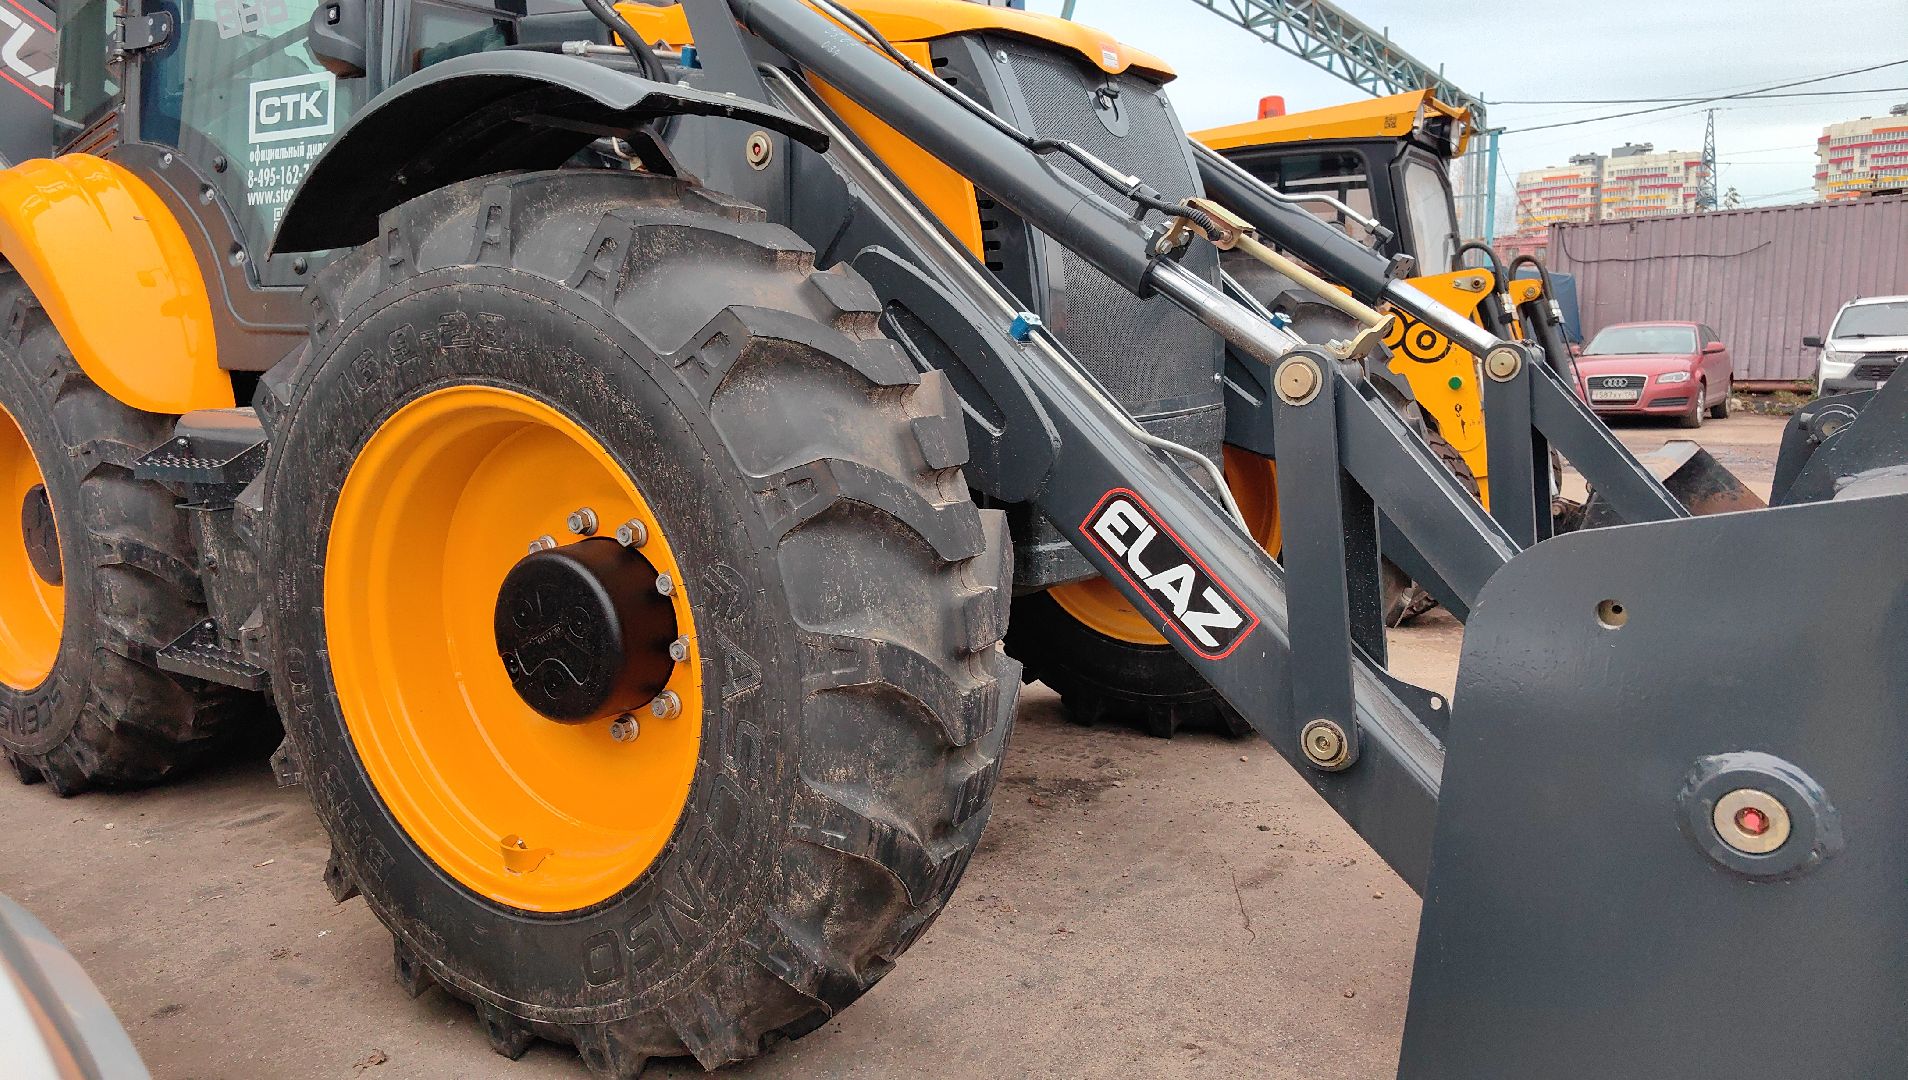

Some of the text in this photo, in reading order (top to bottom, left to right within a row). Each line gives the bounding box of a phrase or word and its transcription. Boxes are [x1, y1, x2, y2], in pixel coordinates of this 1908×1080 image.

[260, 90, 323, 125] СТК
[249, 141, 305, 167] официальный
[1093, 500, 1243, 647] ELAZ
